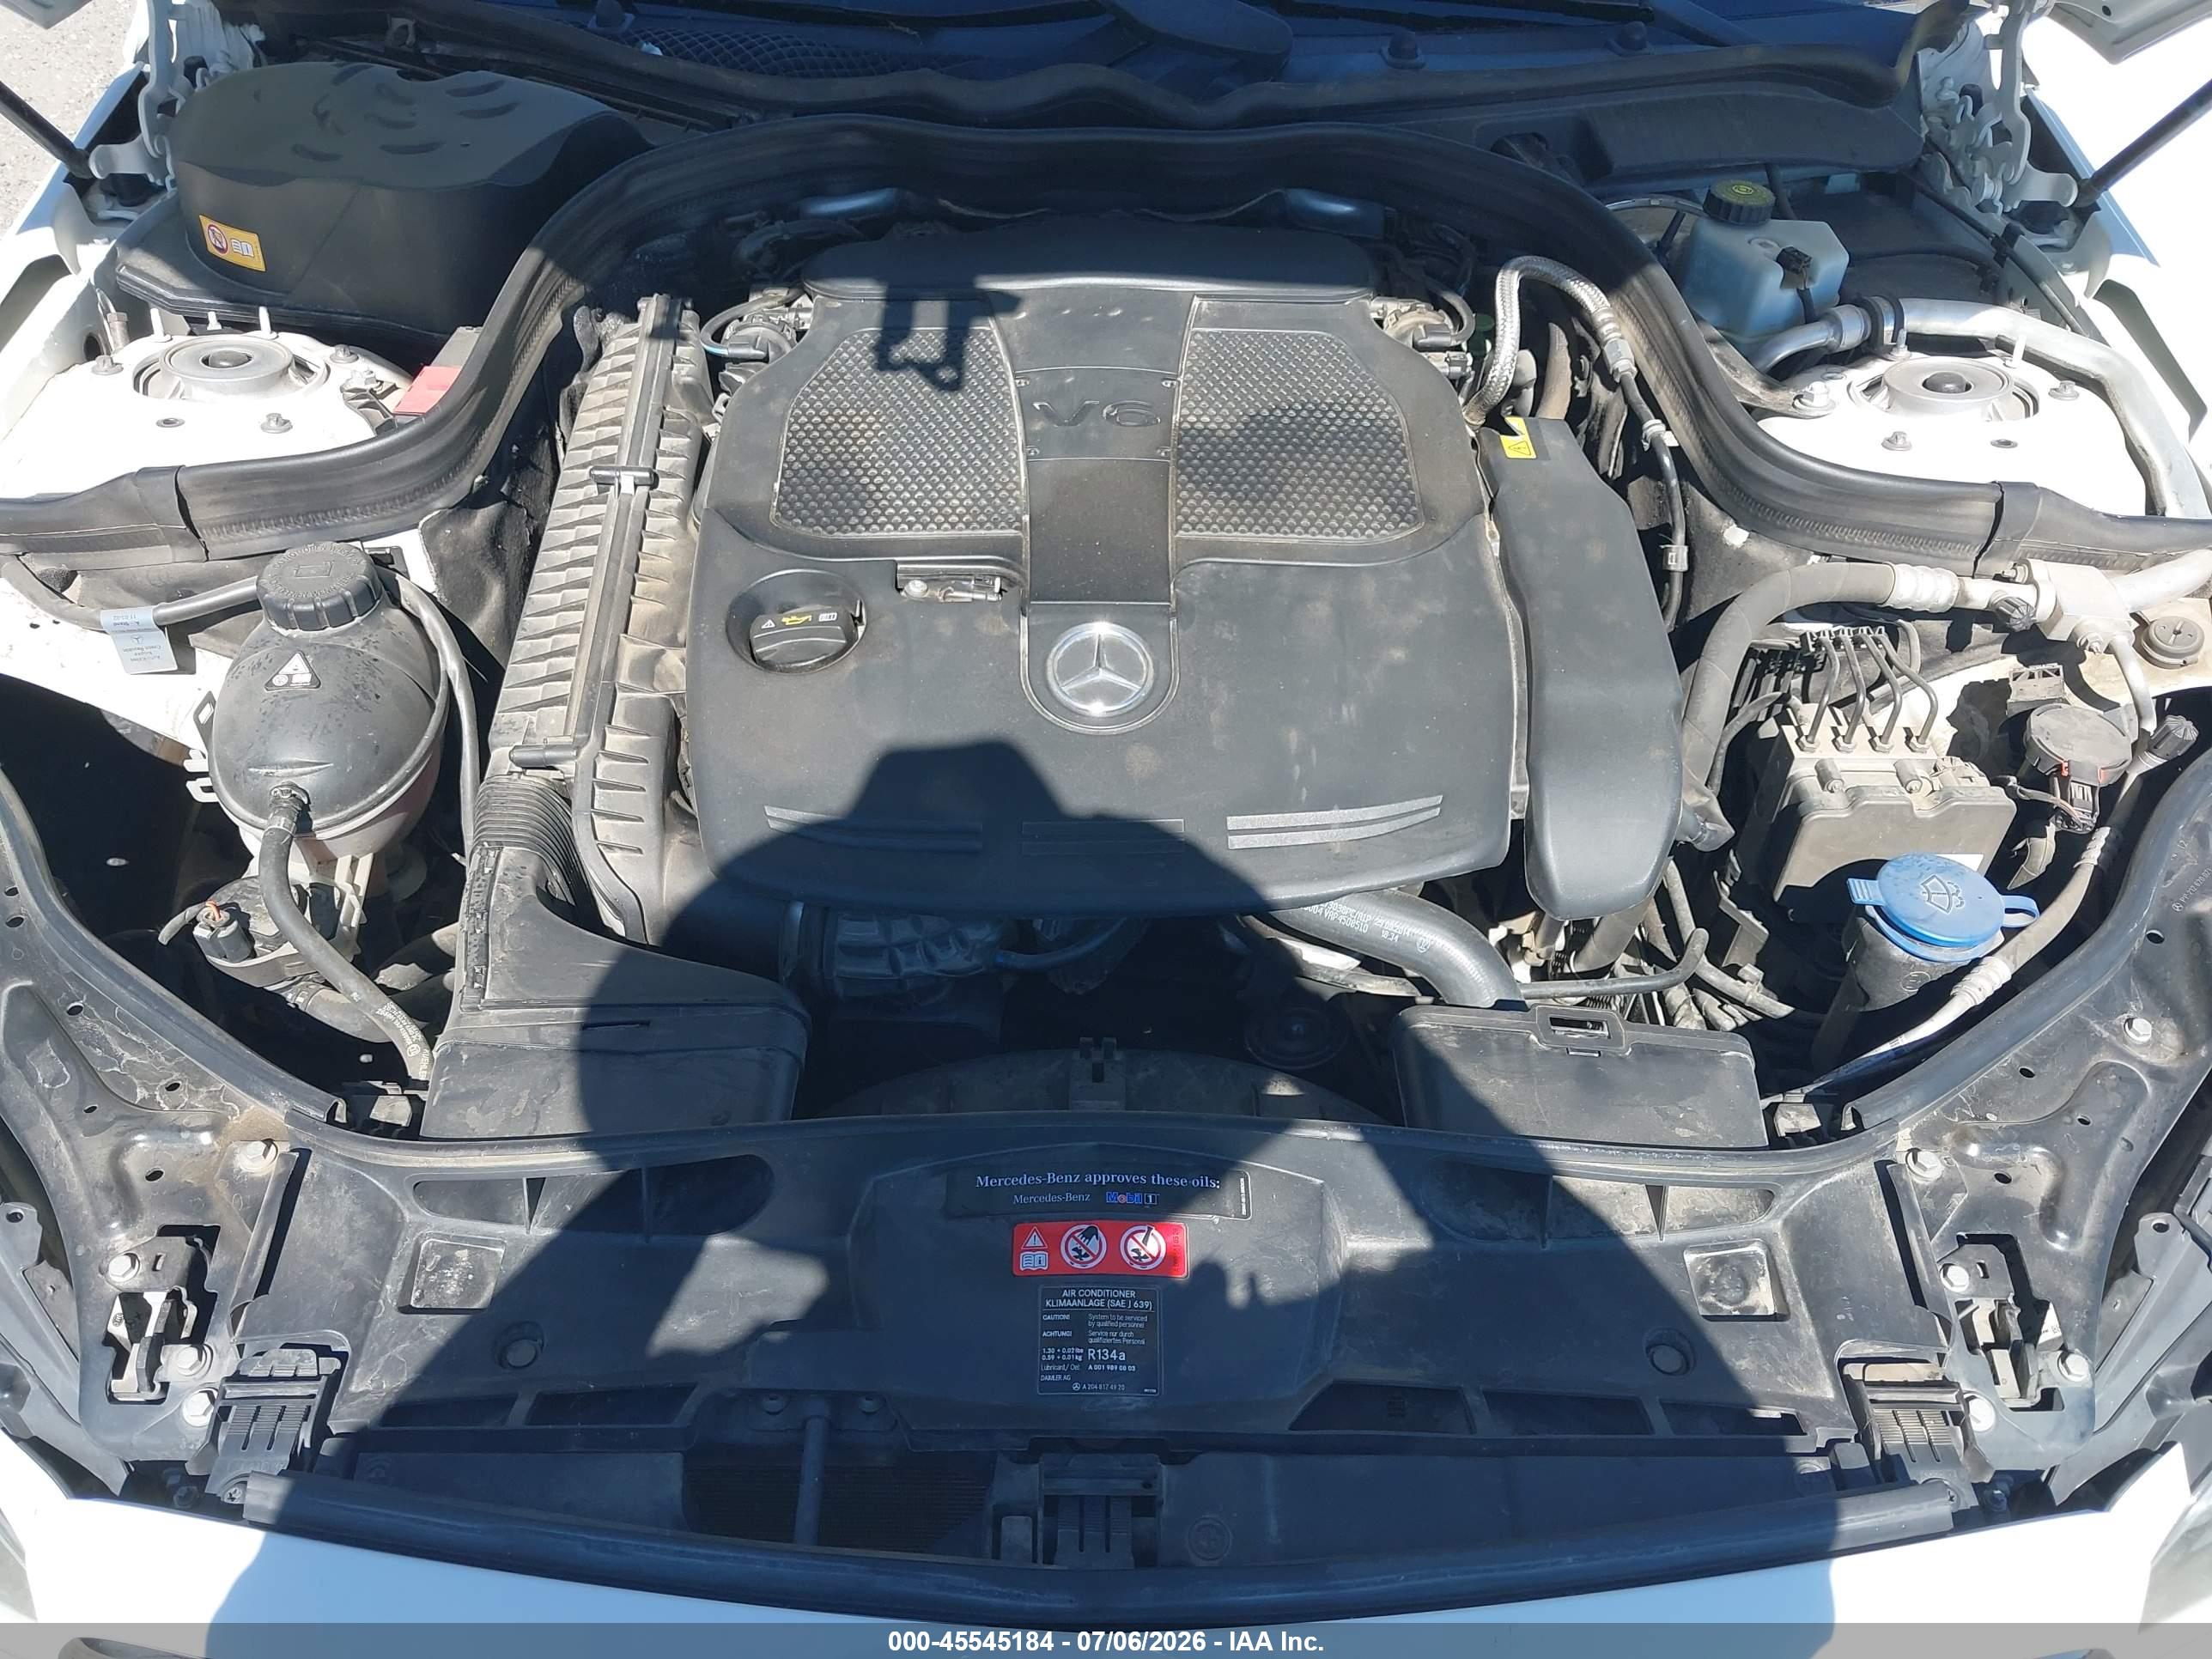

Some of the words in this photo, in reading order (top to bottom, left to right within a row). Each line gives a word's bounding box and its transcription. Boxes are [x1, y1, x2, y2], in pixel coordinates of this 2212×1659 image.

[1032, 400, 1161, 428] V6
[975, 1172, 1081, 1188] Mercedes-Benz
[1085, 1173, 1147, 1185] approves
[1151, 1173, 1188, 1187] these
[1191, 1176, 1221, 1189] oils:
[1013, 1192, 1091, 1204] Mercedes-Benz
[1106, 1191, 1142, 1204] Mobil
[1146, 1194, 1156, 1205] 1
[1062, 1289, 1076, 1297] AIR
[1078, 1289, 1136, 1298] CONDITIONER
[1045, 1299, 1105, 1308] KLIMAANLAGE
[1107, 1299, 1126, 1309] (SAE
[1133, 1300, 1152, 1310] 639)
[1088, 1314, 1109, 1322] System
[1087, 1348, 1126, 1362] R134a
